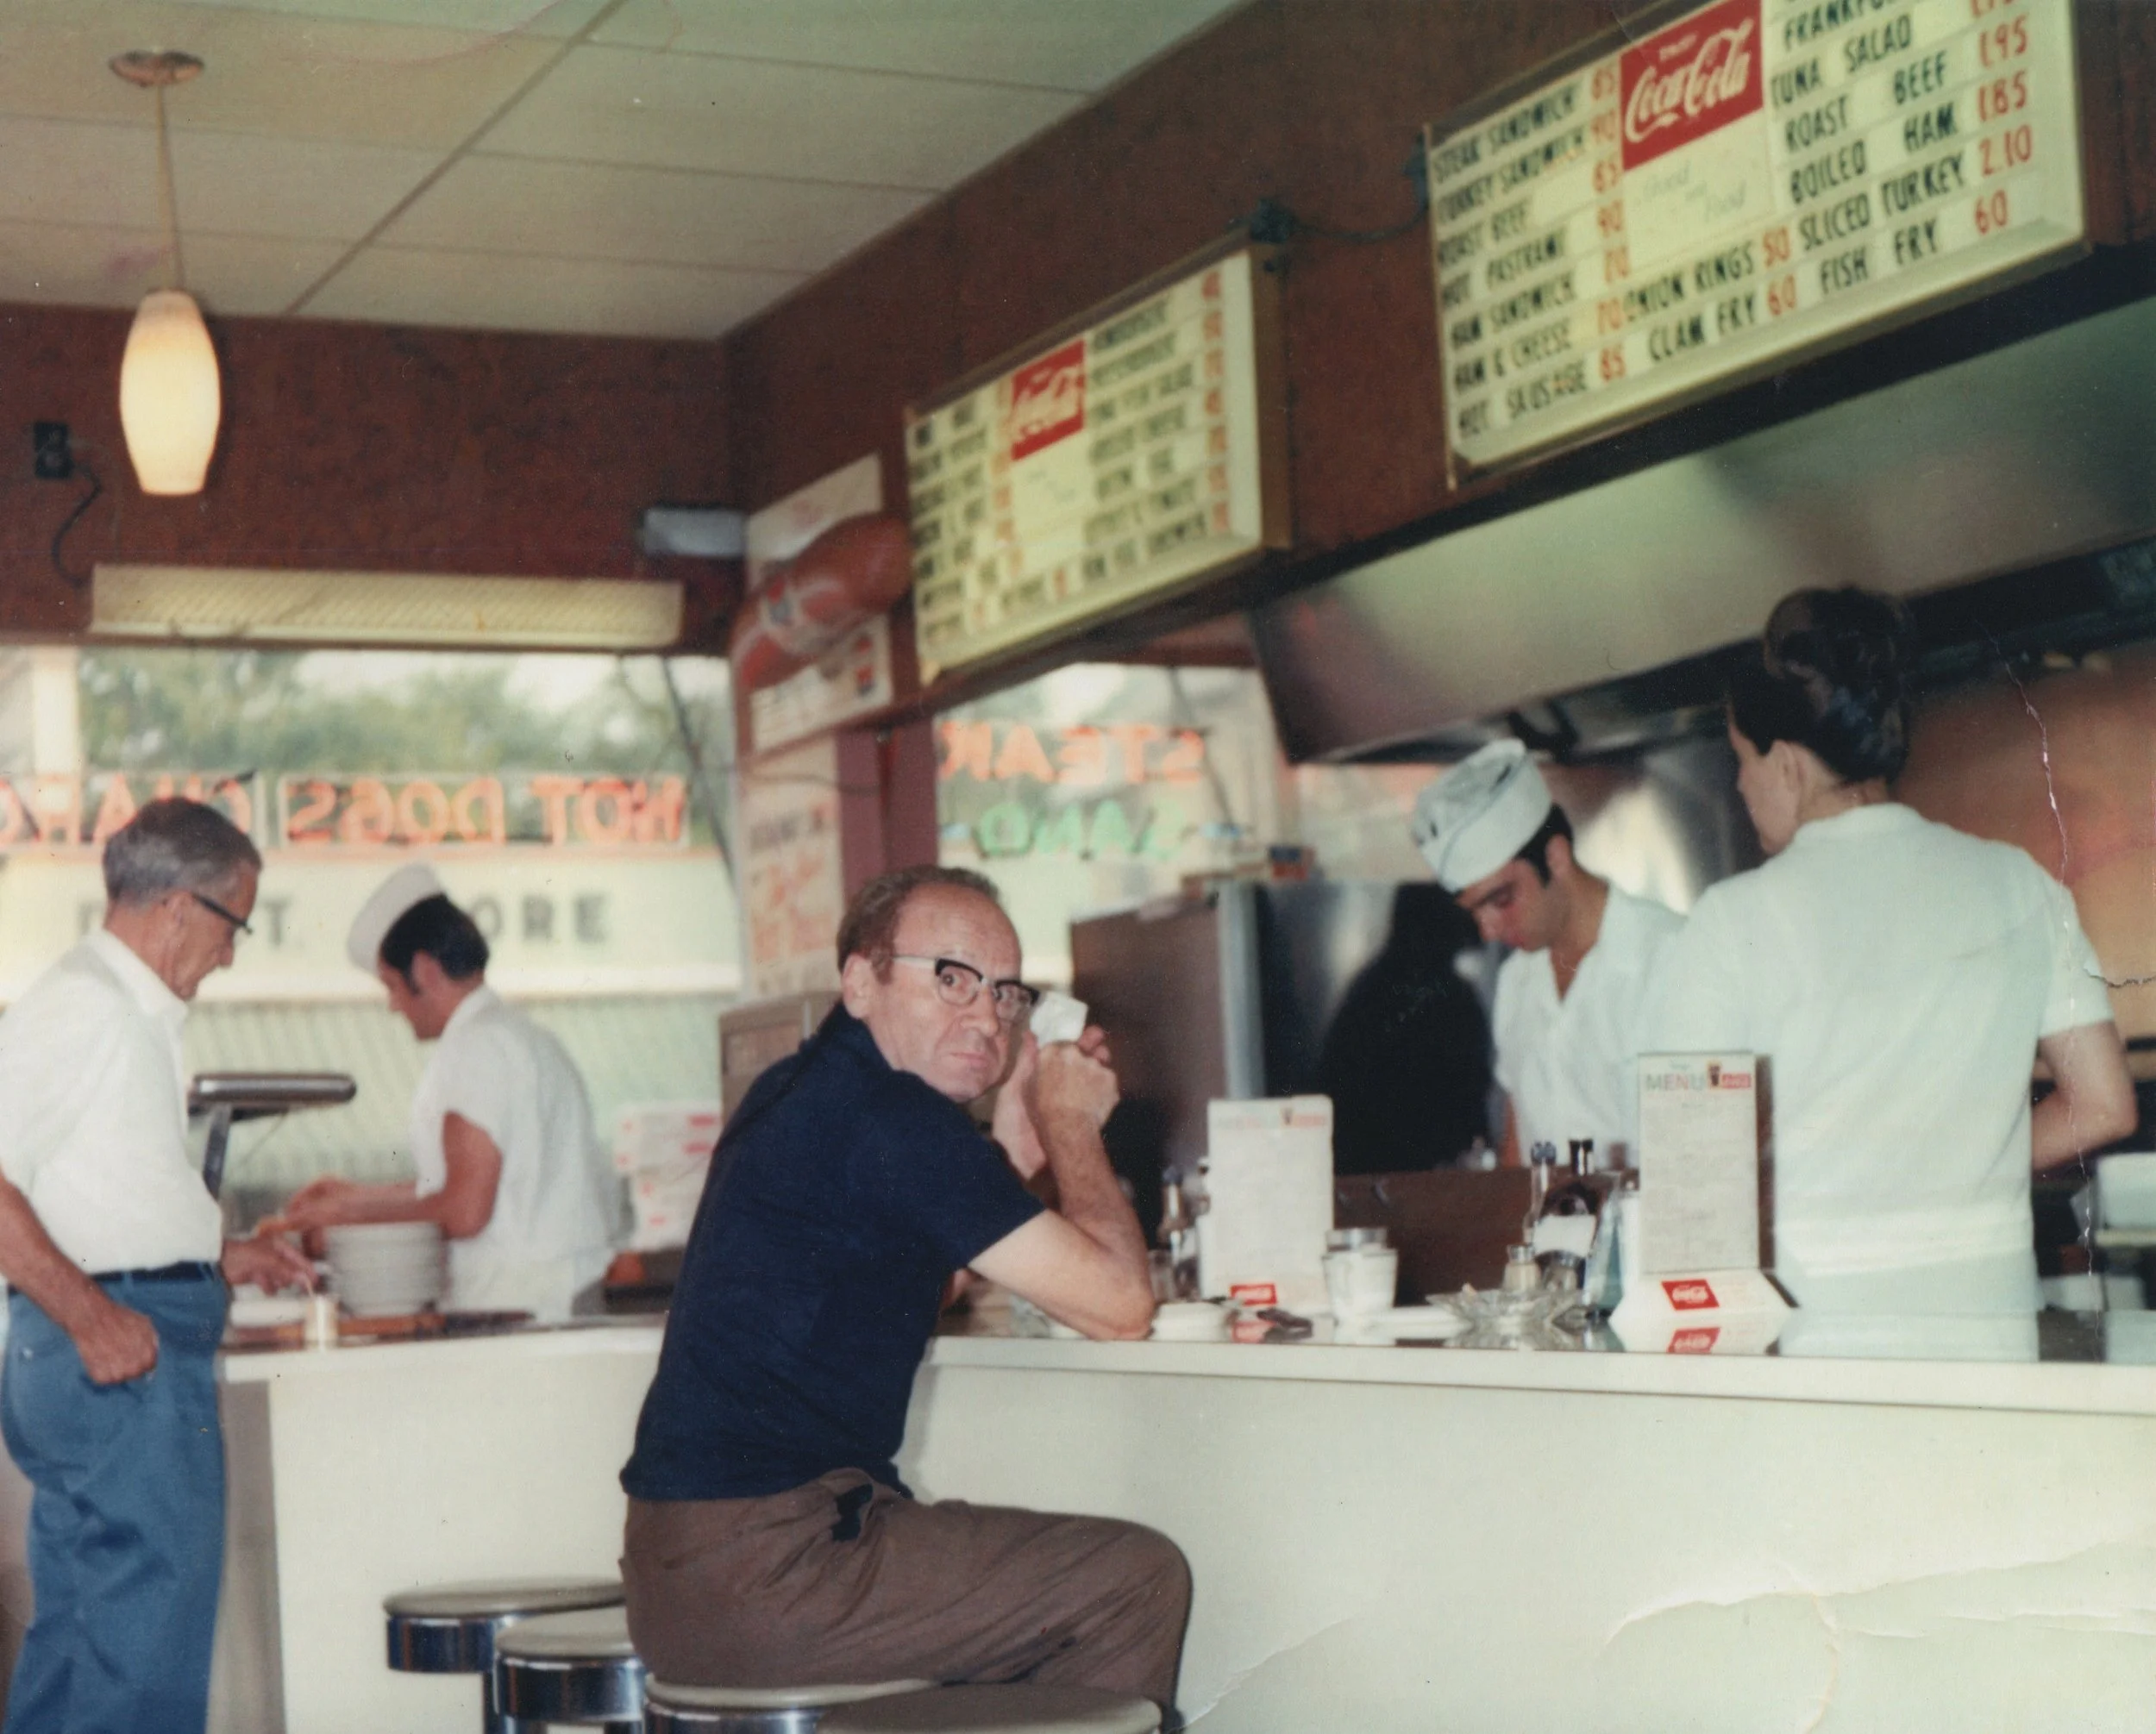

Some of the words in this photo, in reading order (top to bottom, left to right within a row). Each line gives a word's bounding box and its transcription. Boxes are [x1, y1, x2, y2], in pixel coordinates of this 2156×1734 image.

[1771, 58, 1822, 108] TUNA
[1844, 14, 1912, 72] SALAD
[1488, 84, 1576, 157] SANDWICH
[1784, 95, 1849, 153] ROAST
[1893, 51, 1946, 104] BEEF
[1501, 125, 1583, 194] SANDWICH
[1790, 141, 1865, 205] BOILED
[1903, 102, 1958, 153] HAM
[1798, 192, 1871, 251] SLICED
[1881, 153, 1965, 215] TURKEY
[1820, 247, 1868, 295] FISH
[1894, 219, 1940, 265] FRY
[1974, 190, 2008, 235] 60
[1489, 270, 1576, 333] SANDWICH
[1623, 273, 1685, 323] ONION
[1695, 248, 1754, 293] RINGS
[1647, 314, 1704, 362] CLAM
[1716, 291, 1758, 335] FRY
[1767, 274, 1796, 316] 60
[1512, 316, 1571, 368] CHEESE
[1507, 359, 1588, 420] SAUSAGE
[1645, 1073, 1705, 1091] MENU
